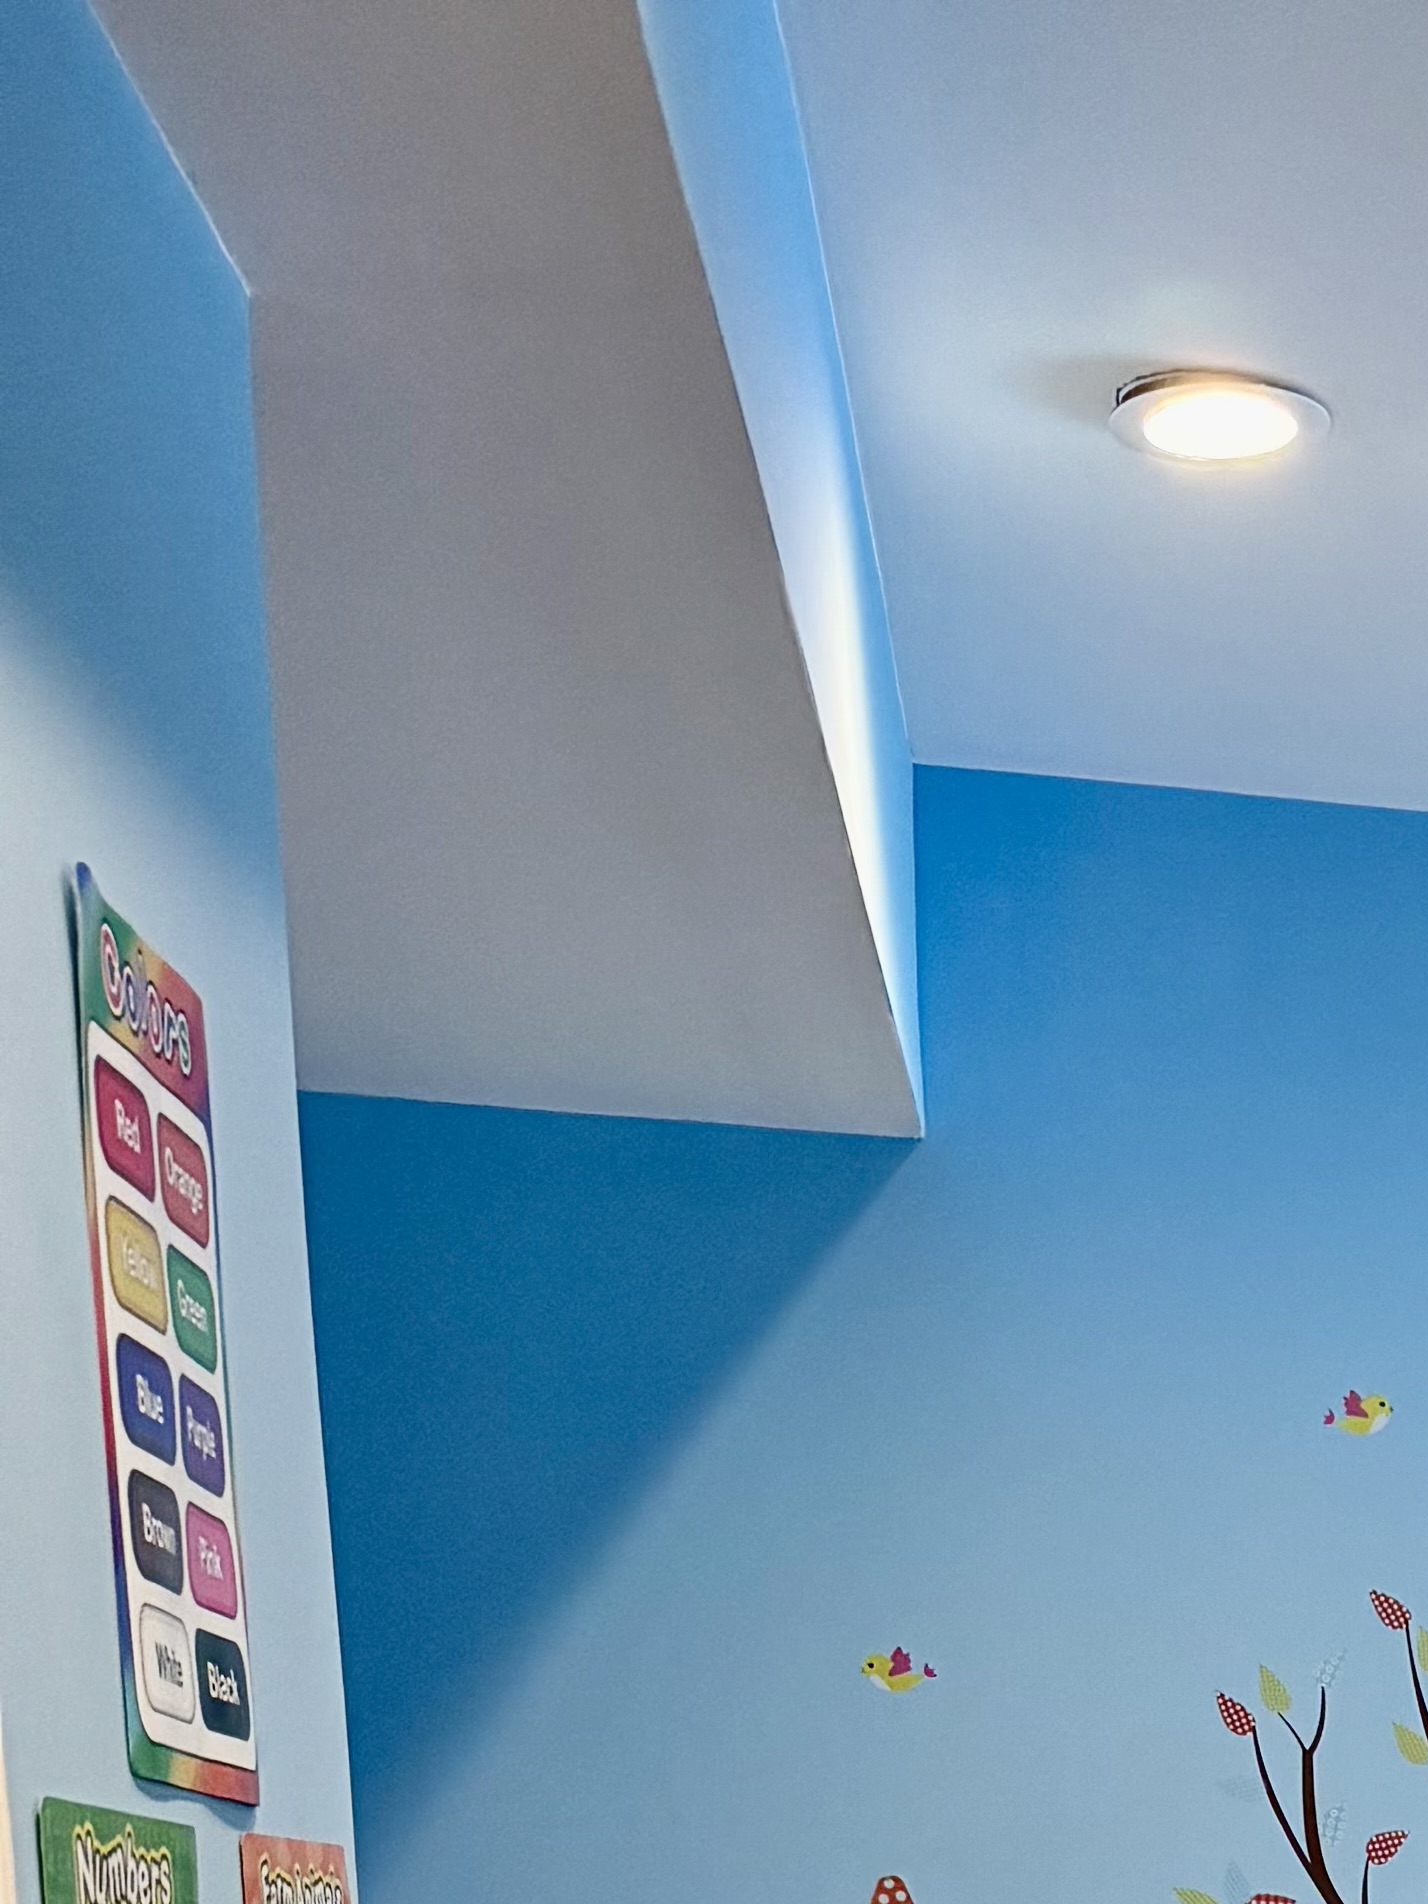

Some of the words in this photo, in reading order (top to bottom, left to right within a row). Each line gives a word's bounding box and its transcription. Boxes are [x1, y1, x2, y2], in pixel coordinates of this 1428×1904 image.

[101, 922, 192, 1076] Colors
[114, 1098, 140, 1154] Red
[164, 1146, 203, 1215] Orange
[118, 1234, 160, 1297] Yellow
[177, 1278, 209, 1335] Green
[135, 1373, 164, 1425] Blue
[186, 1404, 217, 1460] Purple
[141, 1501, 177, 1556] Brown
[198, 1534, 223, 1581] Pink
[155, 1641, 183, 1688] White
[206, 1660, 241, 1706] Black
